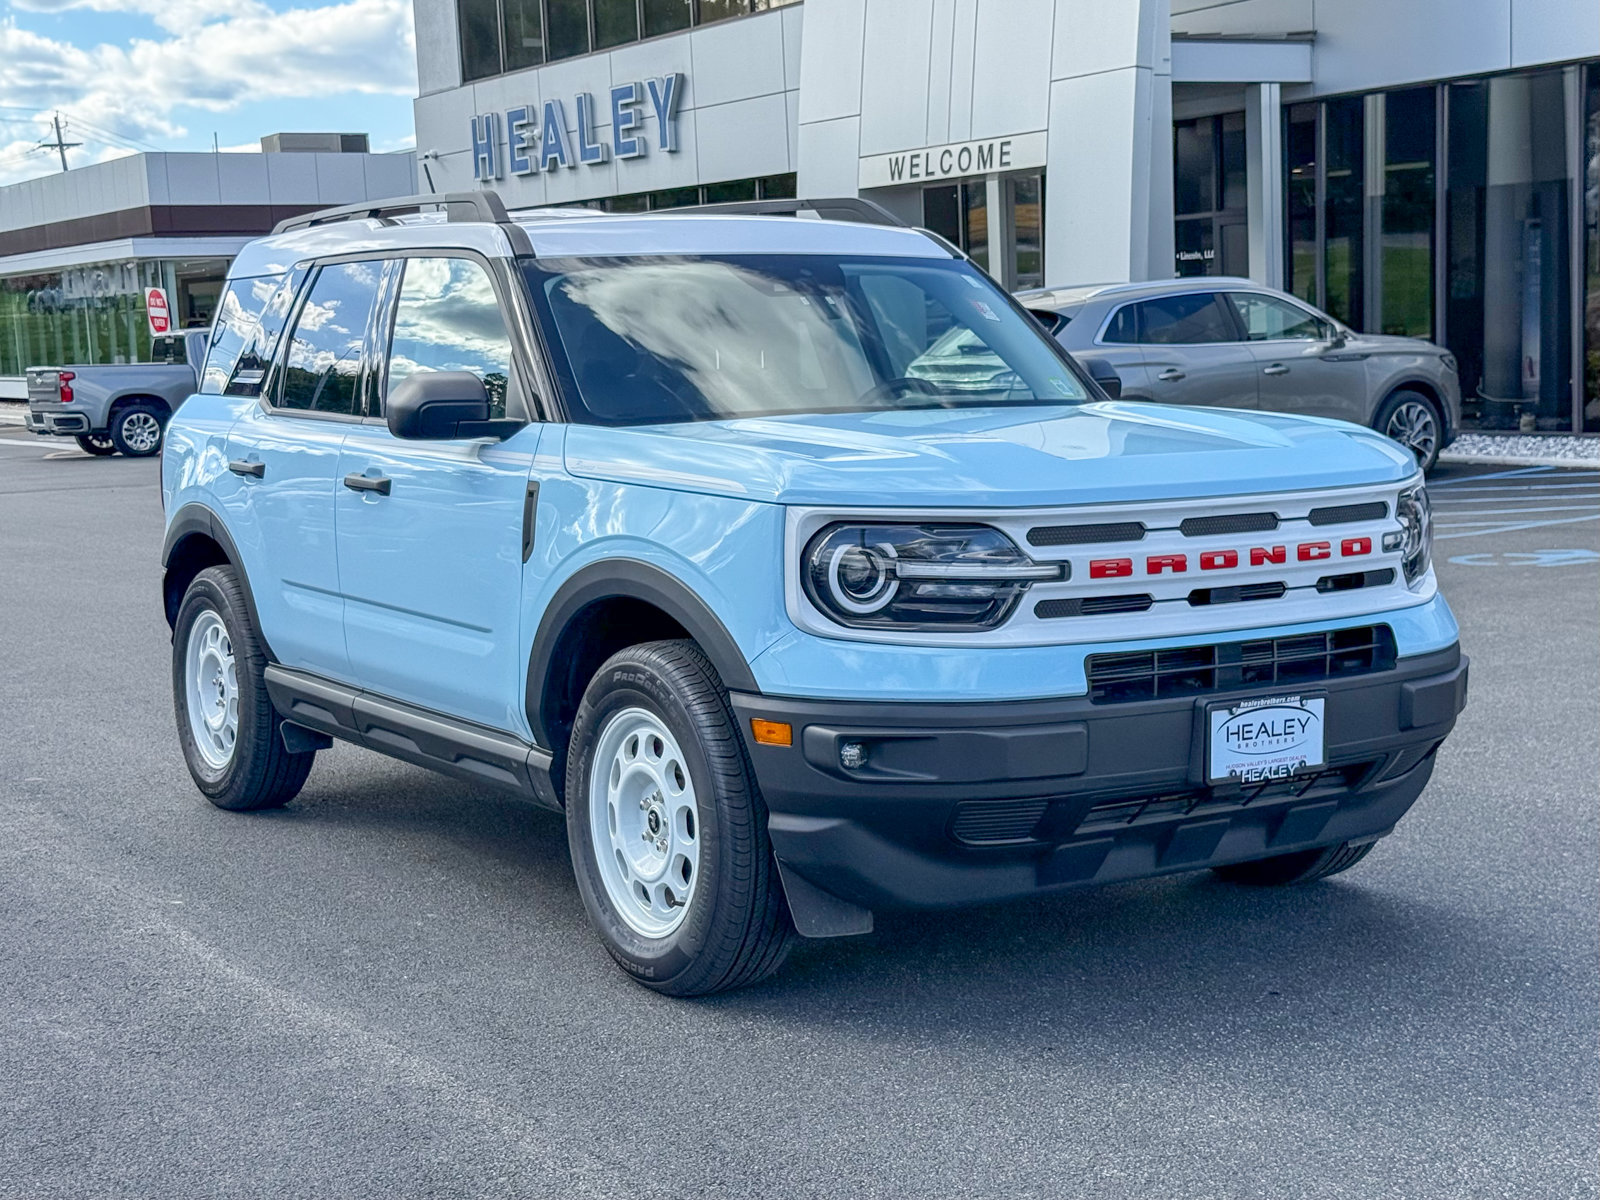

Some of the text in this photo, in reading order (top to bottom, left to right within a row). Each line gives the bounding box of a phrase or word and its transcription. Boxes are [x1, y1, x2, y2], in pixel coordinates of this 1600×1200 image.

[471, 73, 684, 181] HEALEY
[888, 141, 1011, 181] WELCOME
[153, 318, 165, 327] ENTER
[1089, 537, 1372, 579] BRONCO
[1226, 716, 1311, 743] HEALEY
[1237, 737, 1295, 749] BROTHERS
[1241, 762, 1297, 783] HEALEY
[1268, 757, 1288, 765] LARGEST
